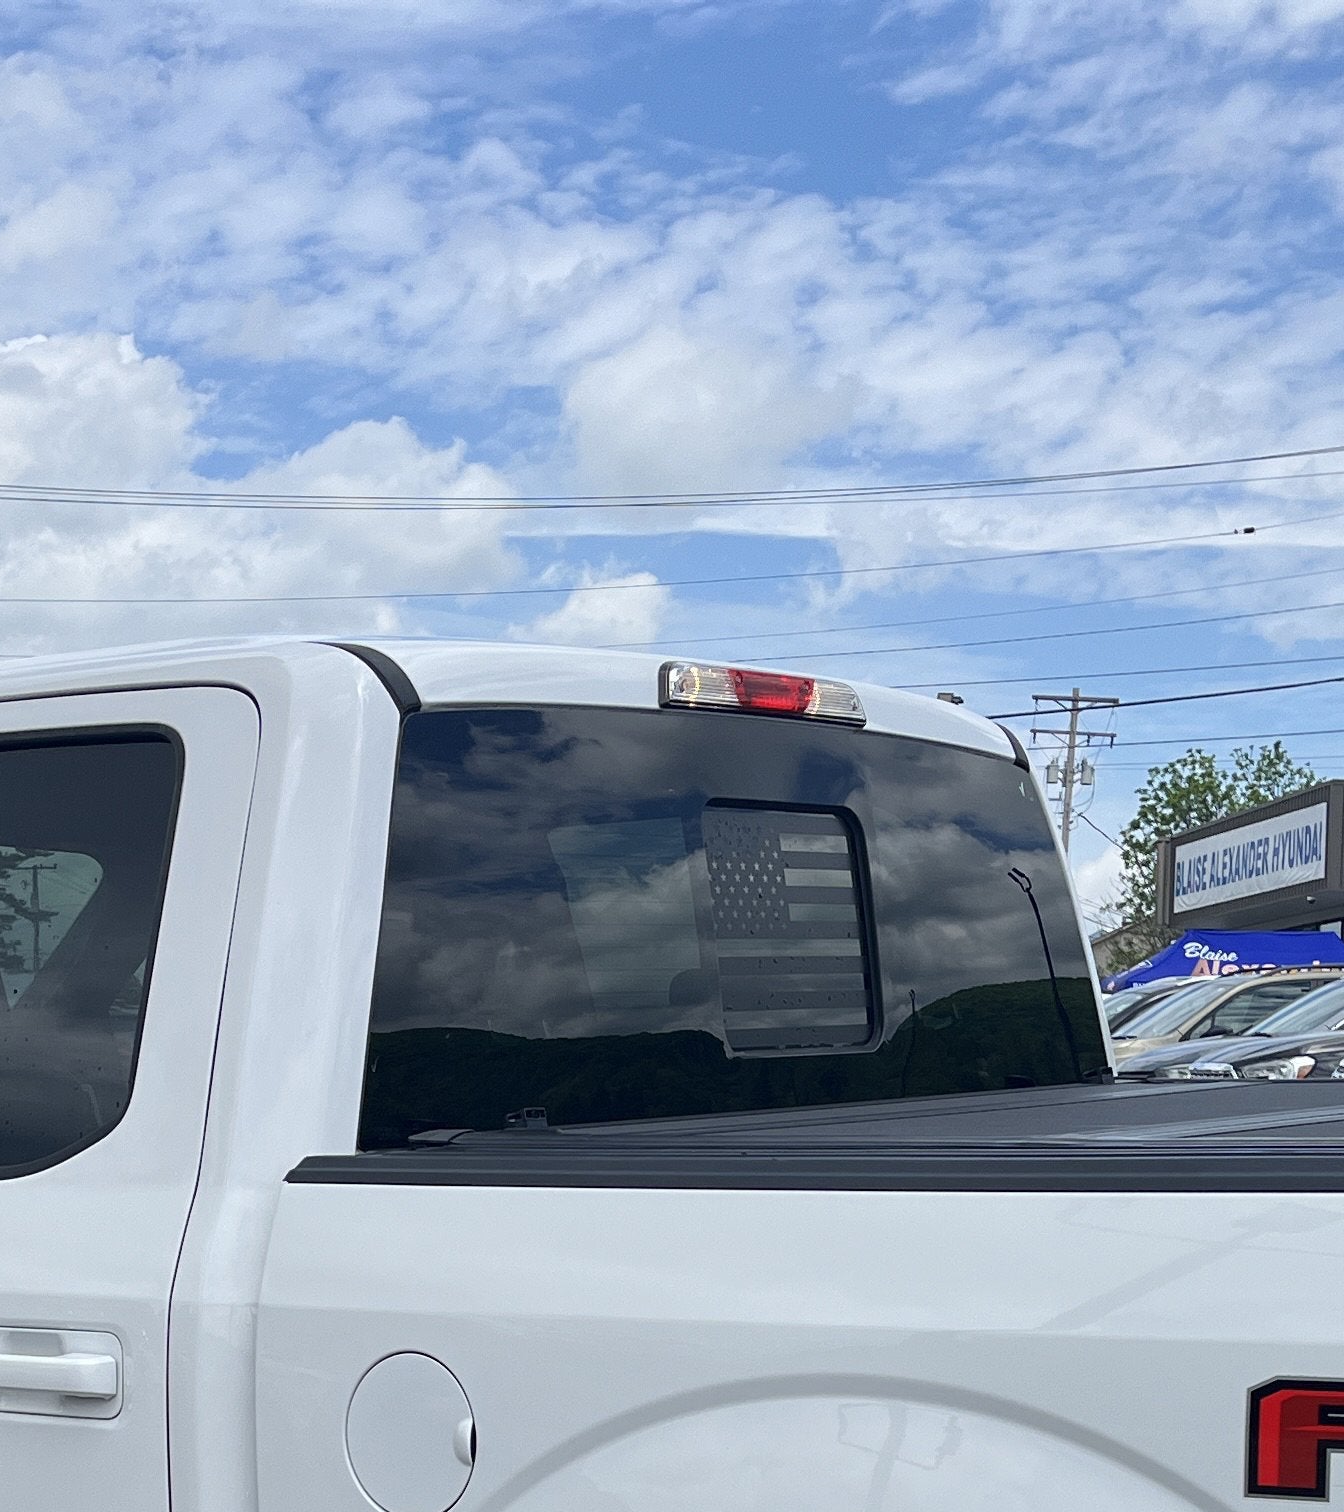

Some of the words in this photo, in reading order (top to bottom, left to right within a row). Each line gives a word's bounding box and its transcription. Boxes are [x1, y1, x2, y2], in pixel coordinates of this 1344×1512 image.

[1176, 854, 1208, 897] BLAISE
[1209, 837, 1270, 889] ALEXANDER
[1272, 821, 1323, 872] HYUNDAI
[1183, 942, 1238, 962] Blaise
